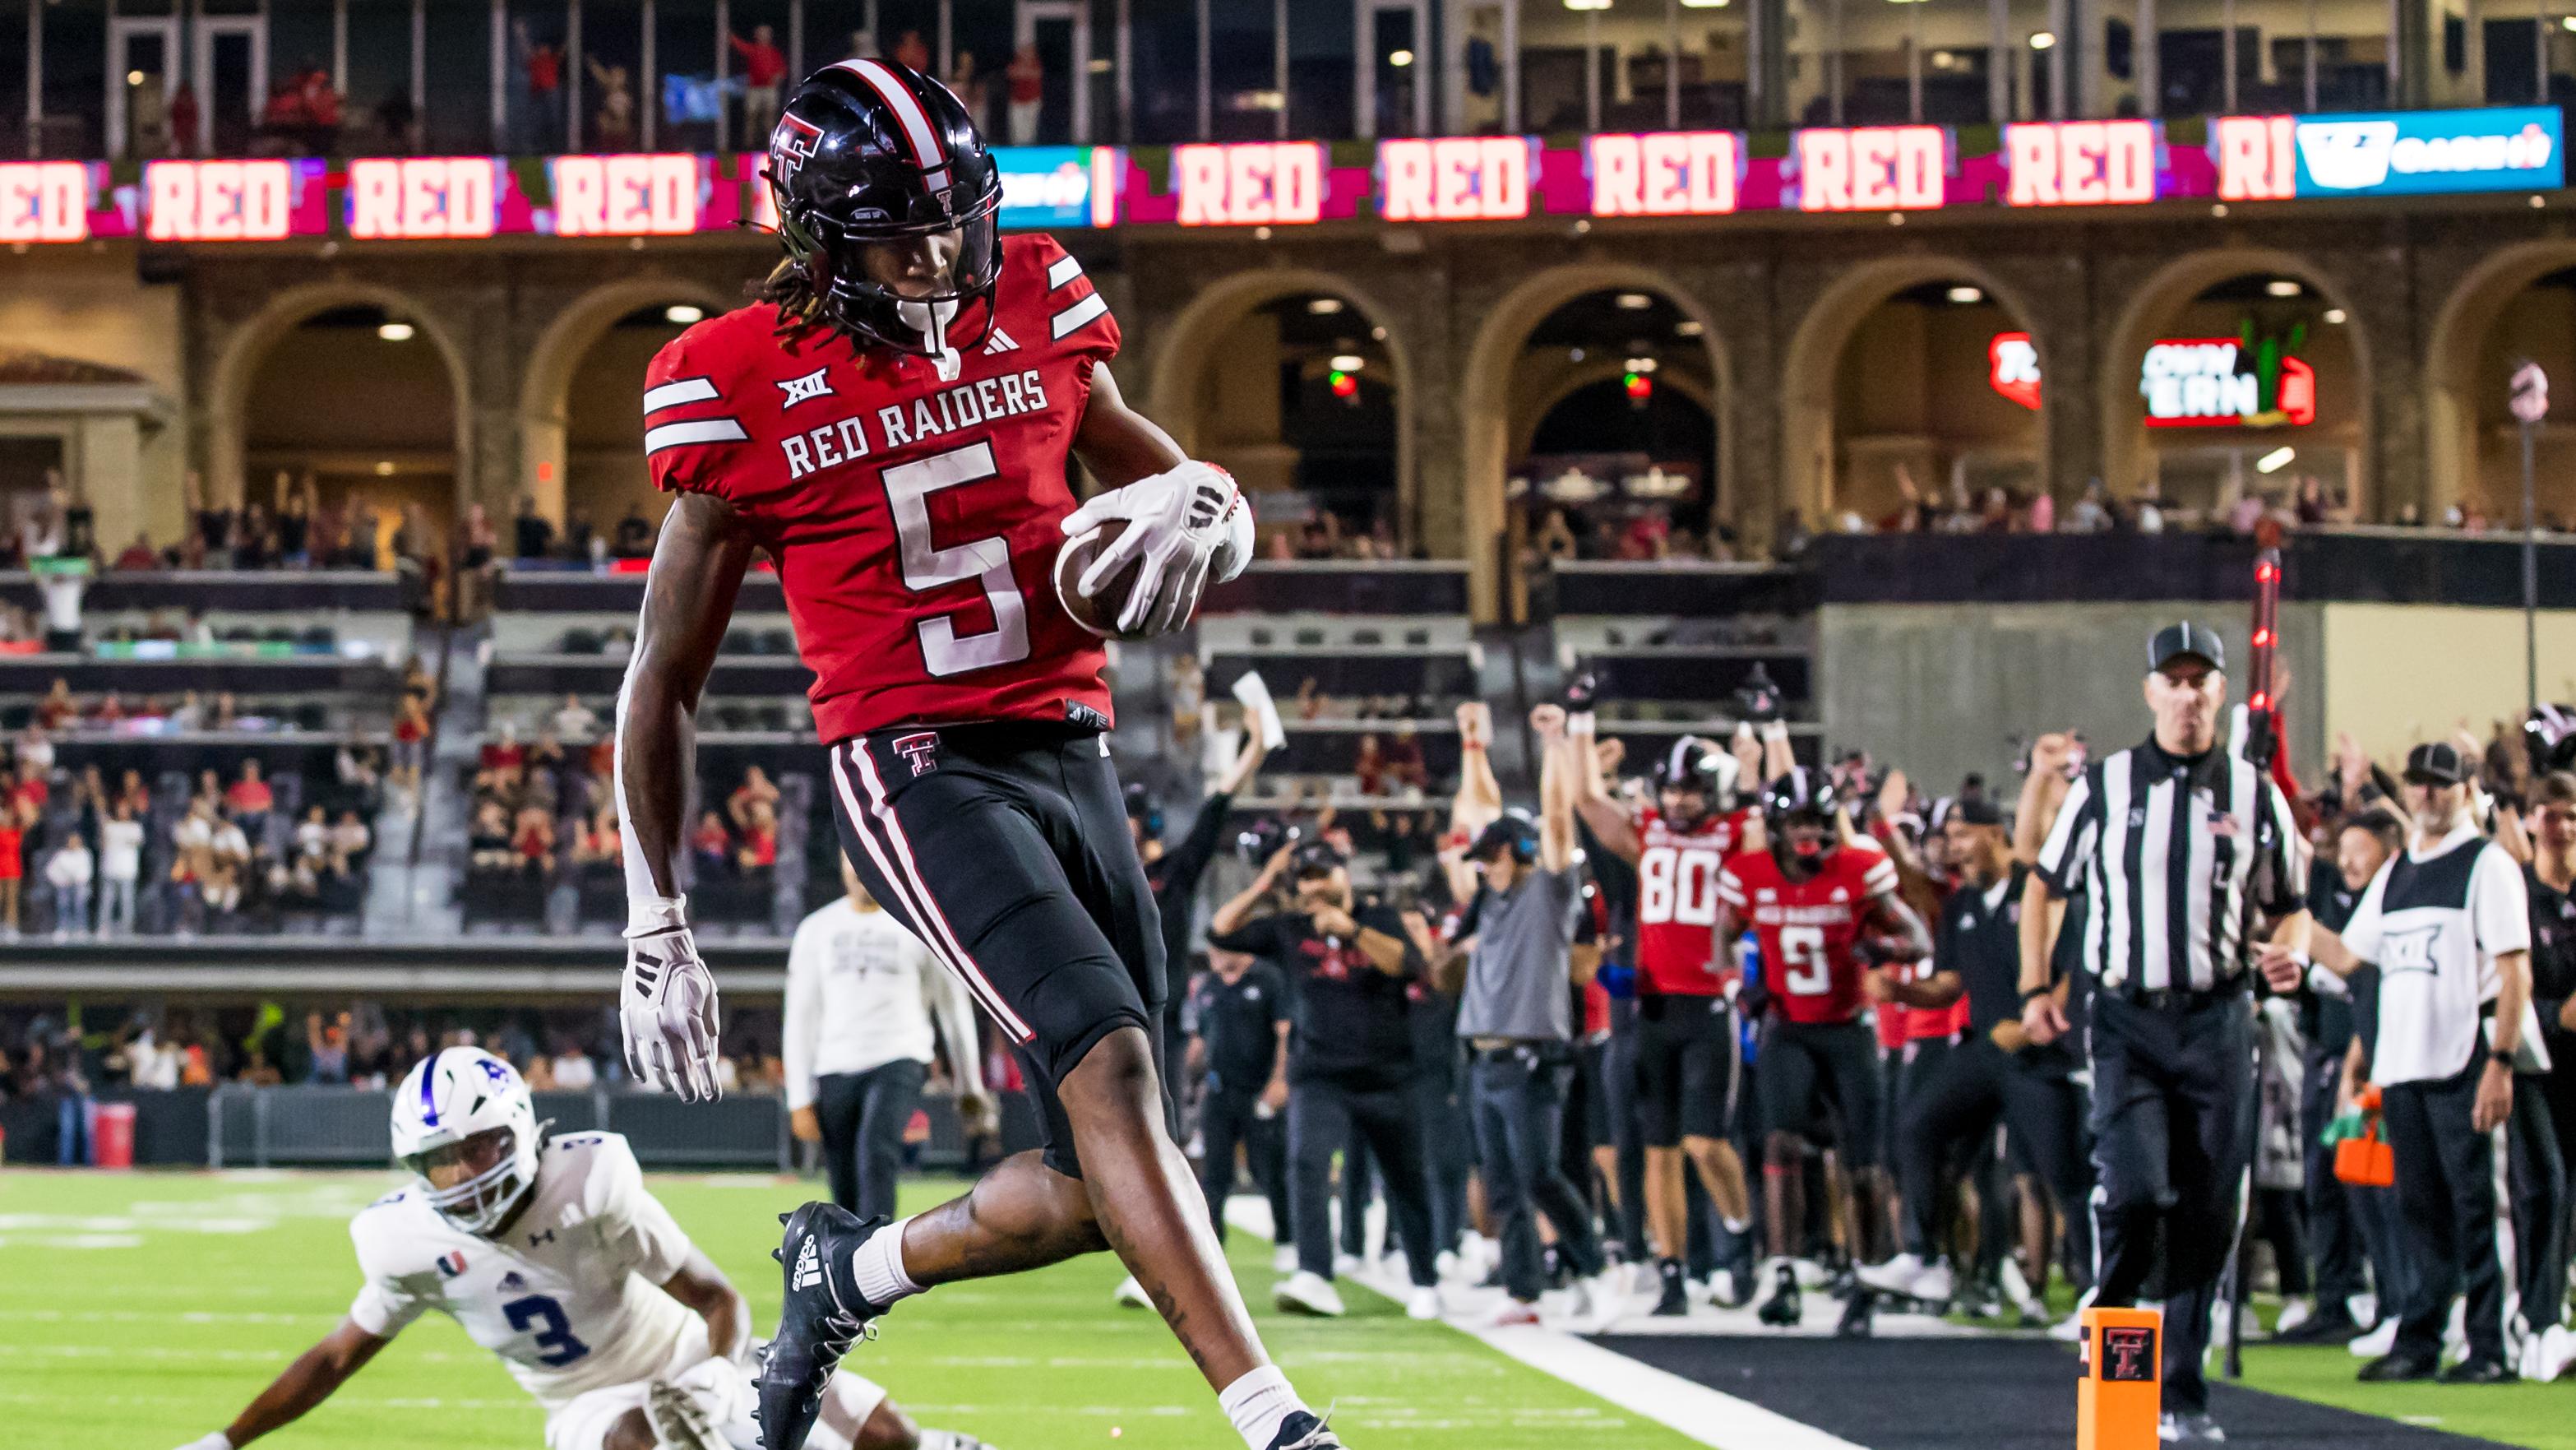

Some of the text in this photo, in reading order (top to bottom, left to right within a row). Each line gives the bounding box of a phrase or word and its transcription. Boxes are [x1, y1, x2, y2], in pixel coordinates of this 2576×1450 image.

[0, 160, 88, 240] ED
[146, 159, 290, 240] RED
[349, 157, 496, 239] RED
[555, 154, 698, 236] RED
[1177, 142, 1320, 225] RED
[1382, 137, 1528, 220] RED
[1590, 132, 1736, 216] RED
[1798, 126, 1945, 211] RED
[2006, 120, 2154, 206] RED
[780, 369, 1049, 480] RED RAIDERS
[881, 440, 1031, 678] 5
[1639, 847, 1721, 925] 80
[1779, 926, 1832, 996] 9
[792, 1234, 815, 1292] adidas
[502, 1294, 592, 1367] 3
